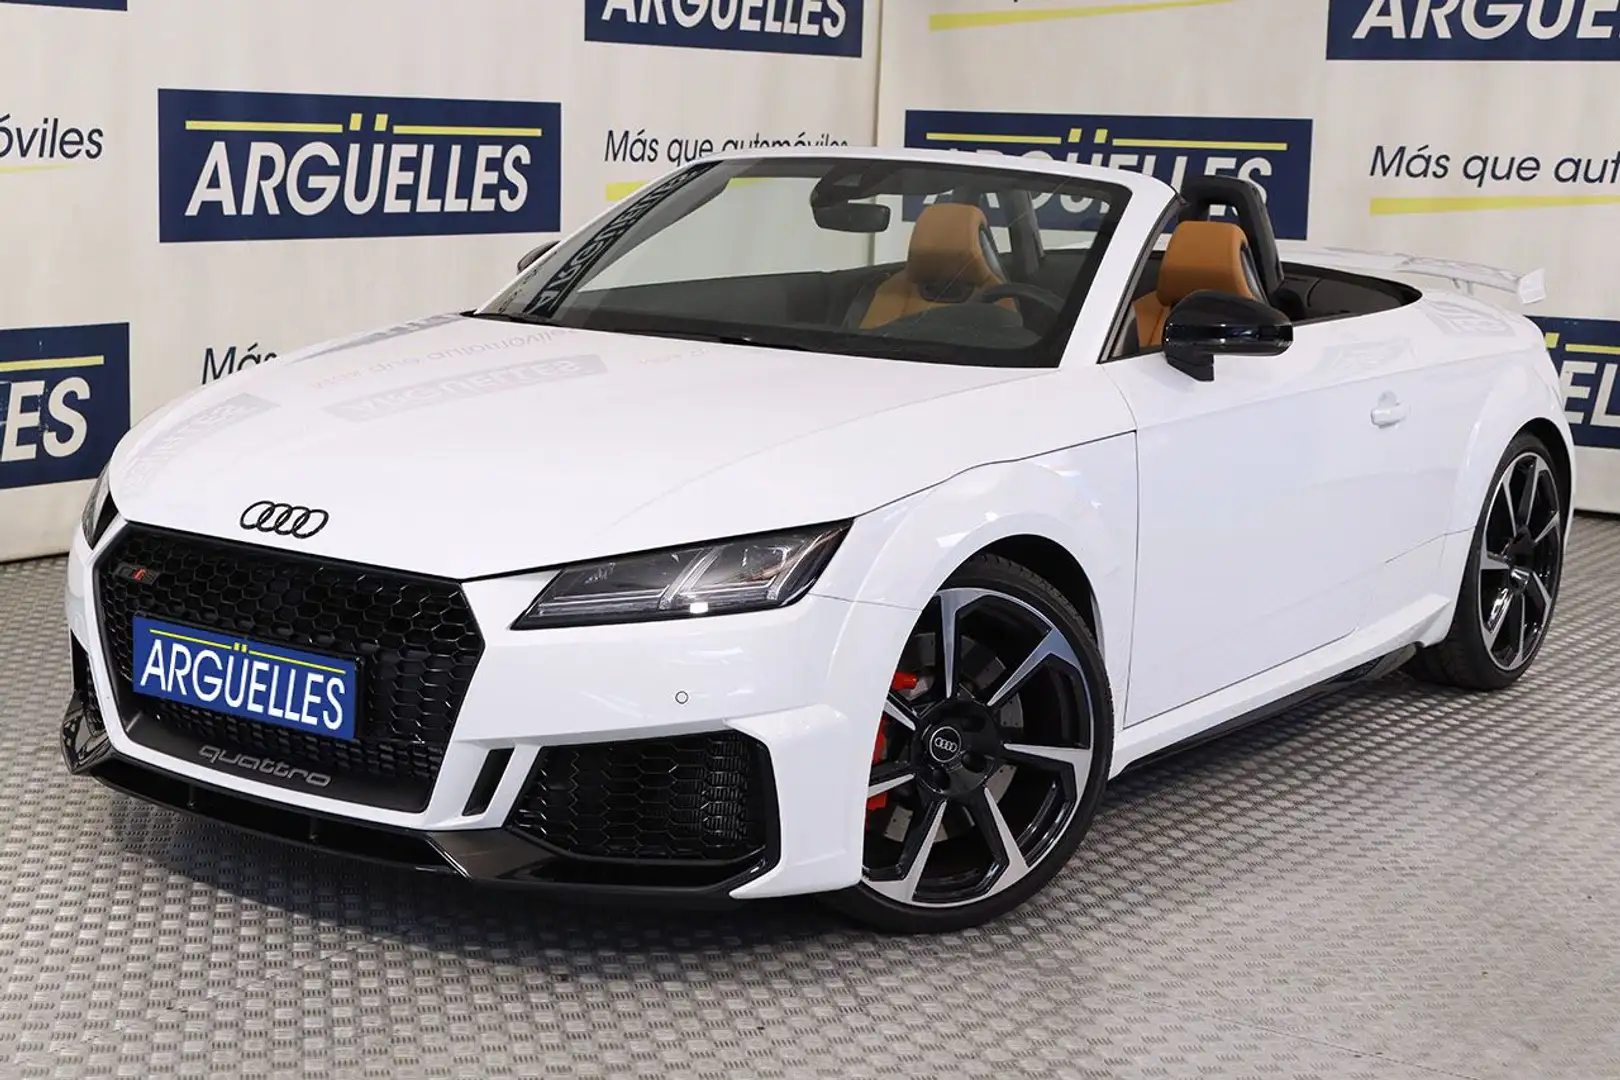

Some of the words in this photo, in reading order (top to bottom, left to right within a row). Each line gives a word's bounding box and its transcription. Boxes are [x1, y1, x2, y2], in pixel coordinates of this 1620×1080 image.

[1352, 0, 1620, 40] ARGE
[185, 113, 531, 216] ARGÜELLES
[604, 129, 658, 162] Más
[667, 138, 714, 167] que
[1370, 144, 1451, 179] Más
[1463, 155, 1541, 188] que
[202, 342, 278, 385] Má
[140, 638, 346, 731] ARGÜELLES
[199, 744, 332, 788] quattro
